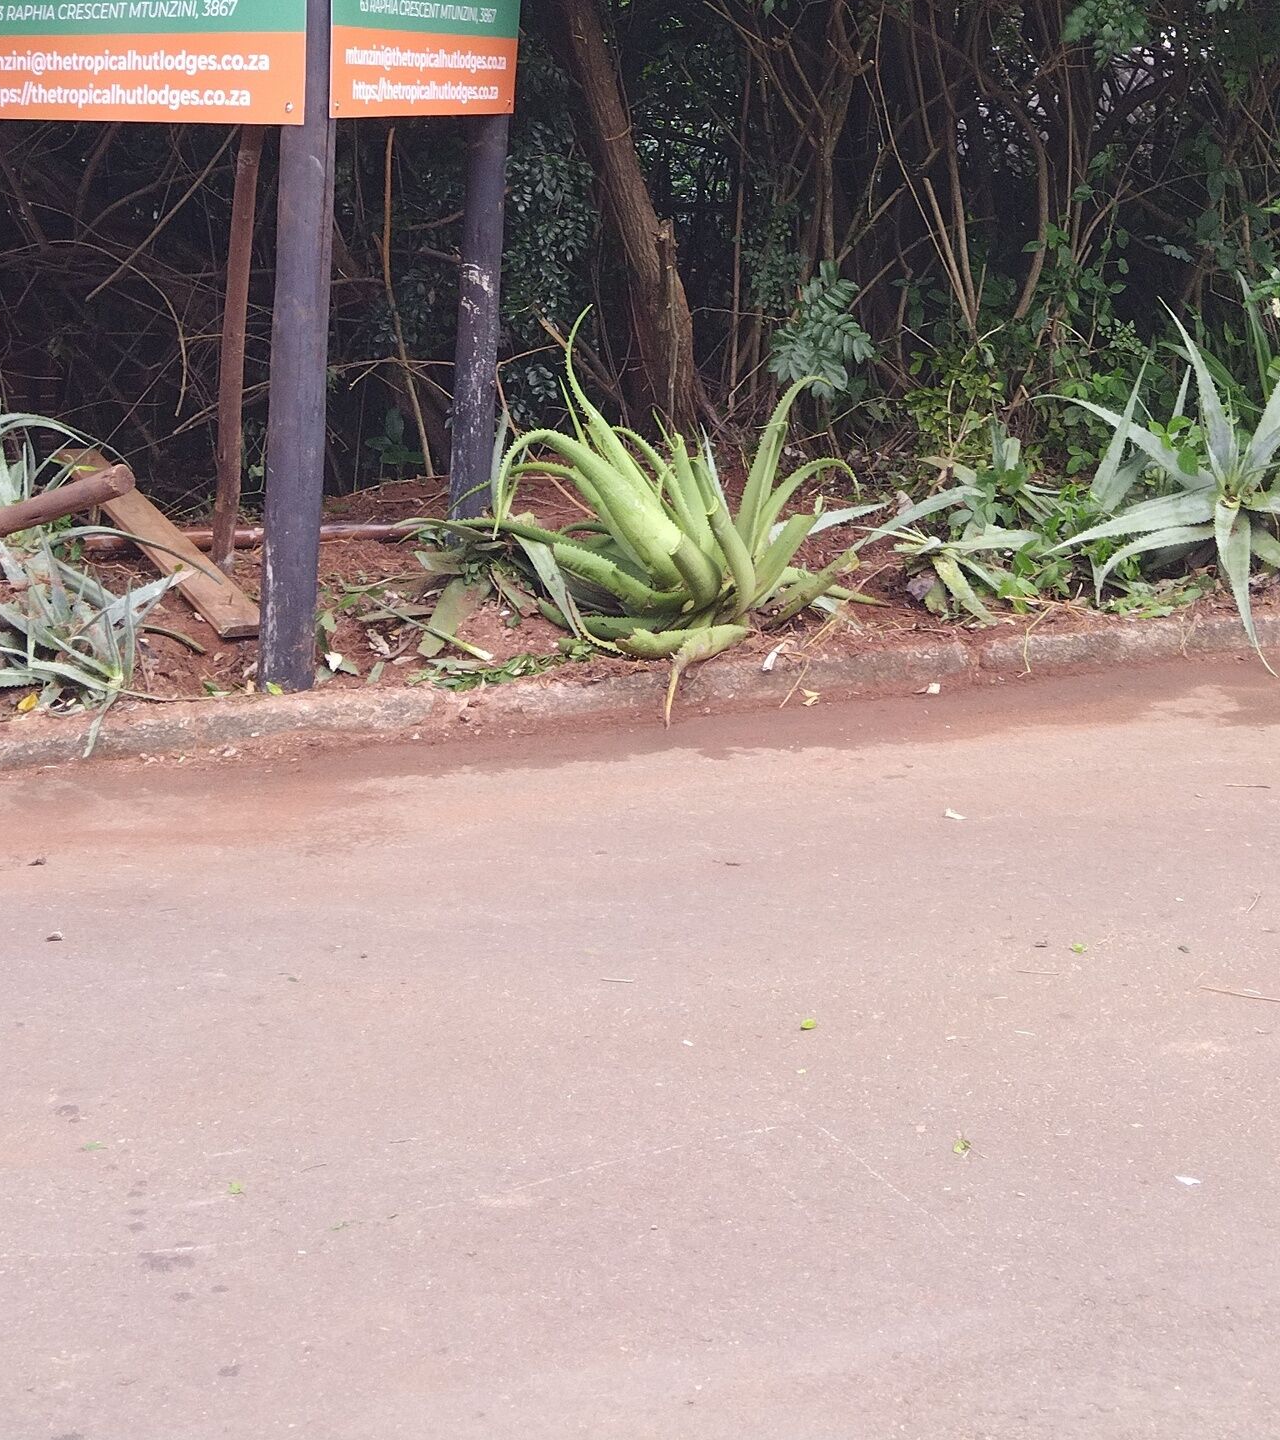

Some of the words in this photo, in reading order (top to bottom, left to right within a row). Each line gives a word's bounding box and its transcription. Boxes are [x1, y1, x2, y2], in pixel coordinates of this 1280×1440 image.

[7, 4, 55, 21] RAPHIA
[58, 2, 126, 19] CRESCENT
[129, 1, 199, 20] MTUNZINI,
[202, 0, 238, 17] 3867
[400, 0, 440, 18] CRESCENT
[440, 5, 478, 24] MTUNZINI,
[479, 7, 497, 23] 3867
[345, 43, 506, 73] mtunzini@thetropicalhutlodges.co.za
